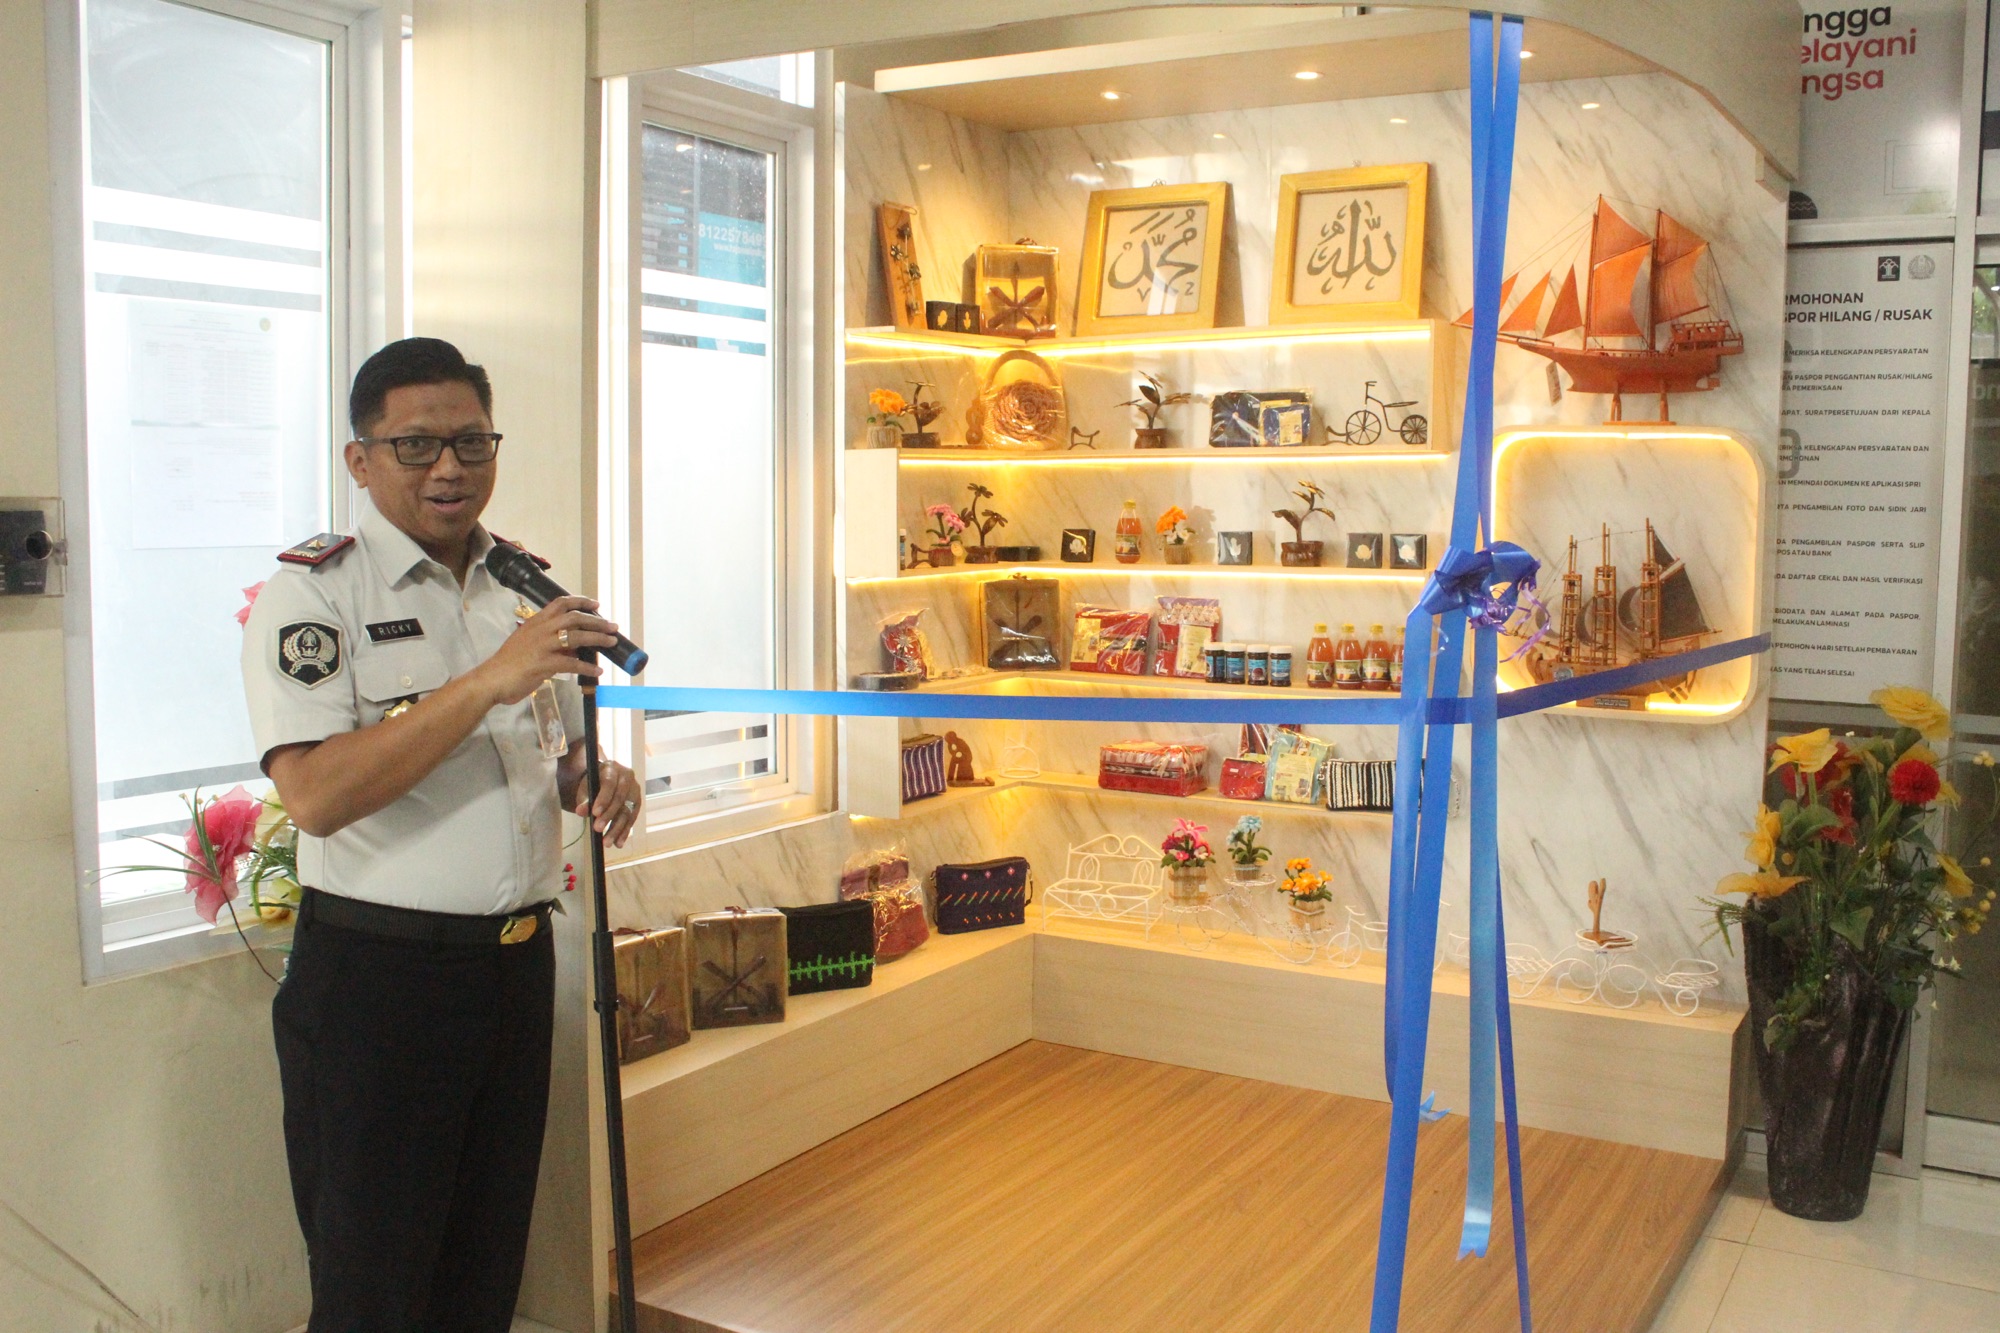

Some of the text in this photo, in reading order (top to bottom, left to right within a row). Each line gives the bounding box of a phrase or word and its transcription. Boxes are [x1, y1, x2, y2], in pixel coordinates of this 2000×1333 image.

[1804, 6, 1891, 39] ngga
[1802, 70, 1884, 101] ngsa
[1820, 310, 1872, 322] HILANG
[1874, 309, 1881, 323] /
[1883, 309, 1933, 321] RUSAK
[1821, 348, 1874, 356] KELENGKAPAN
[1774, 607, 1806, 615] BIODATA
[1772, 618, 1816, 626] MELAKUKAN
[378, 623, 412, 636] RICKY
[1774, 642, 1811, 650] PEMOHON
[1835, 645, 1866, 653] SETELAH
[1866, 647, 1918, 655] PEMBAYARAN
[1827, 669, 1855, 677] SELESAI
